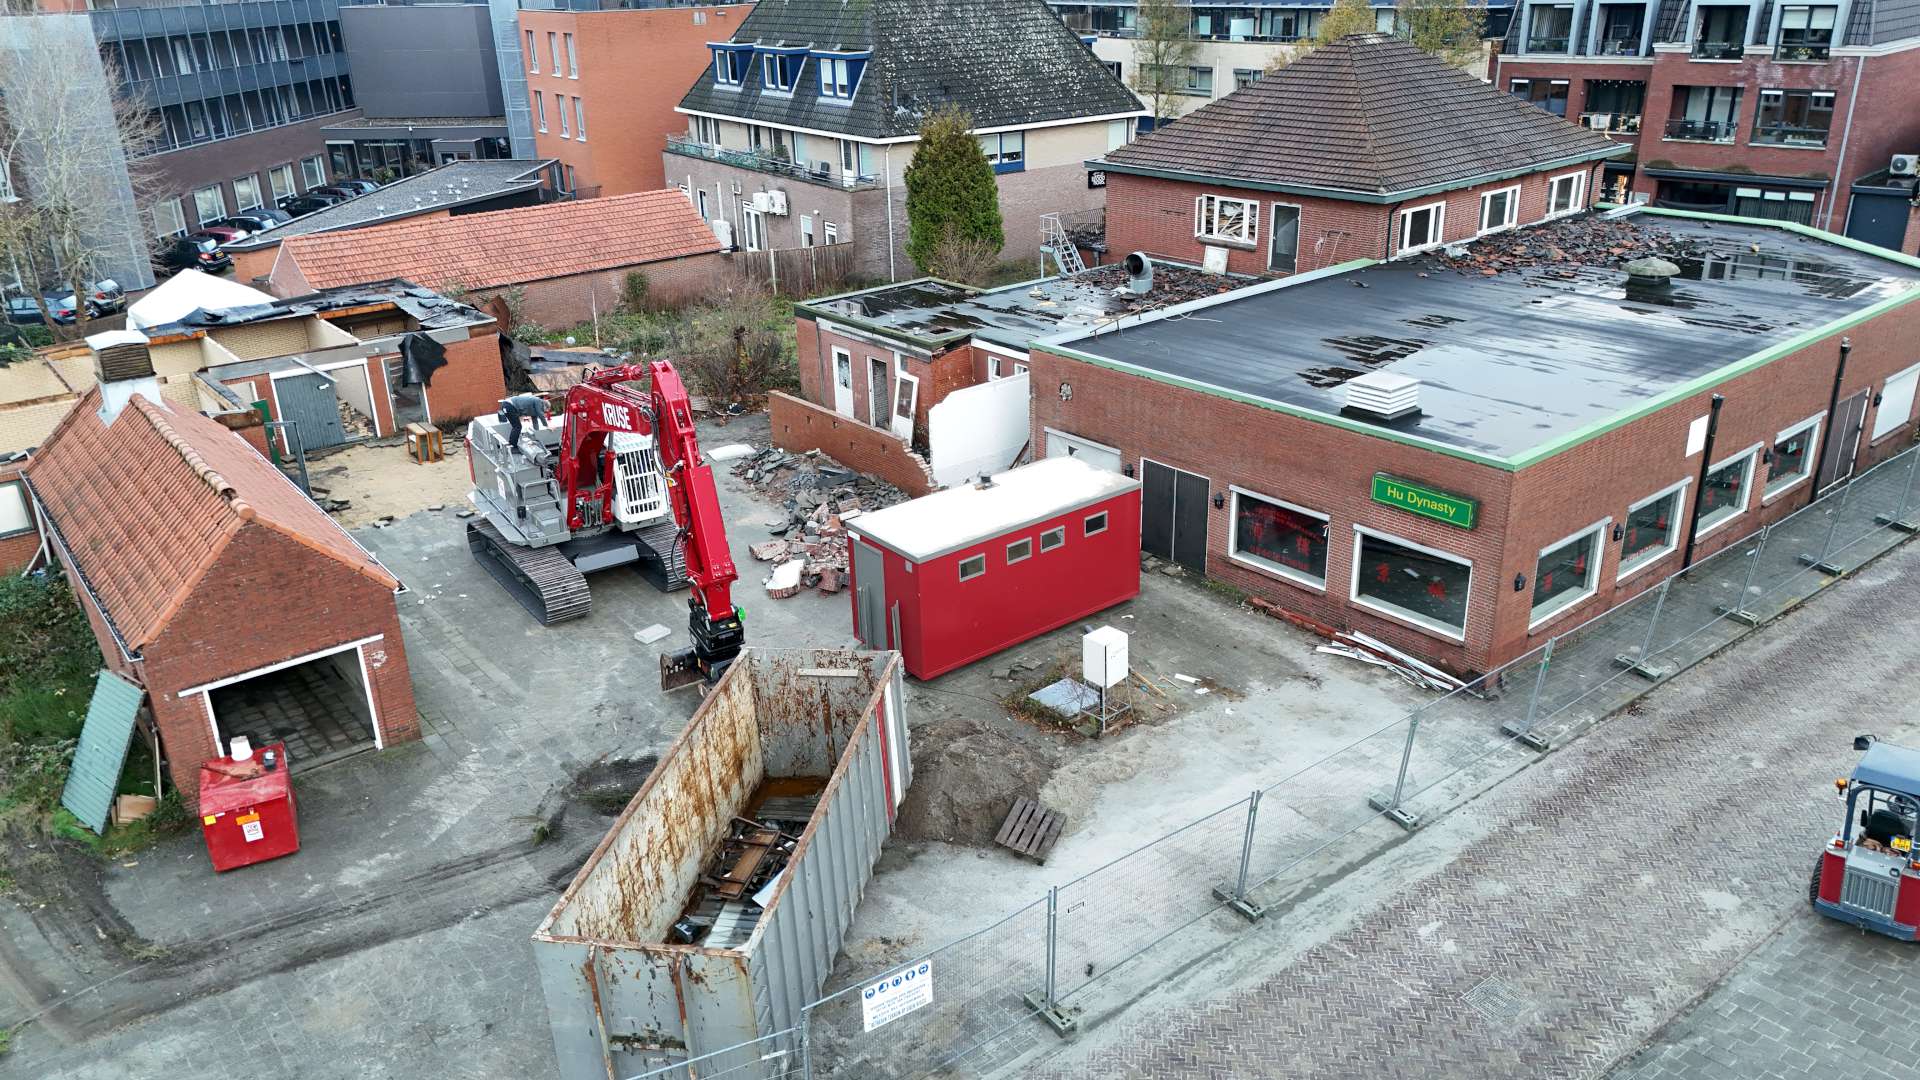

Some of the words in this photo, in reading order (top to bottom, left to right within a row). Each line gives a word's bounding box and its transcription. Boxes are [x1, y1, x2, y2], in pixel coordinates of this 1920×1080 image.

[601, 401, 632, 431] KRUSE
[1387, 485, 1404, 500] Hu
[1407, 491, 1456, 518] Dynasty
